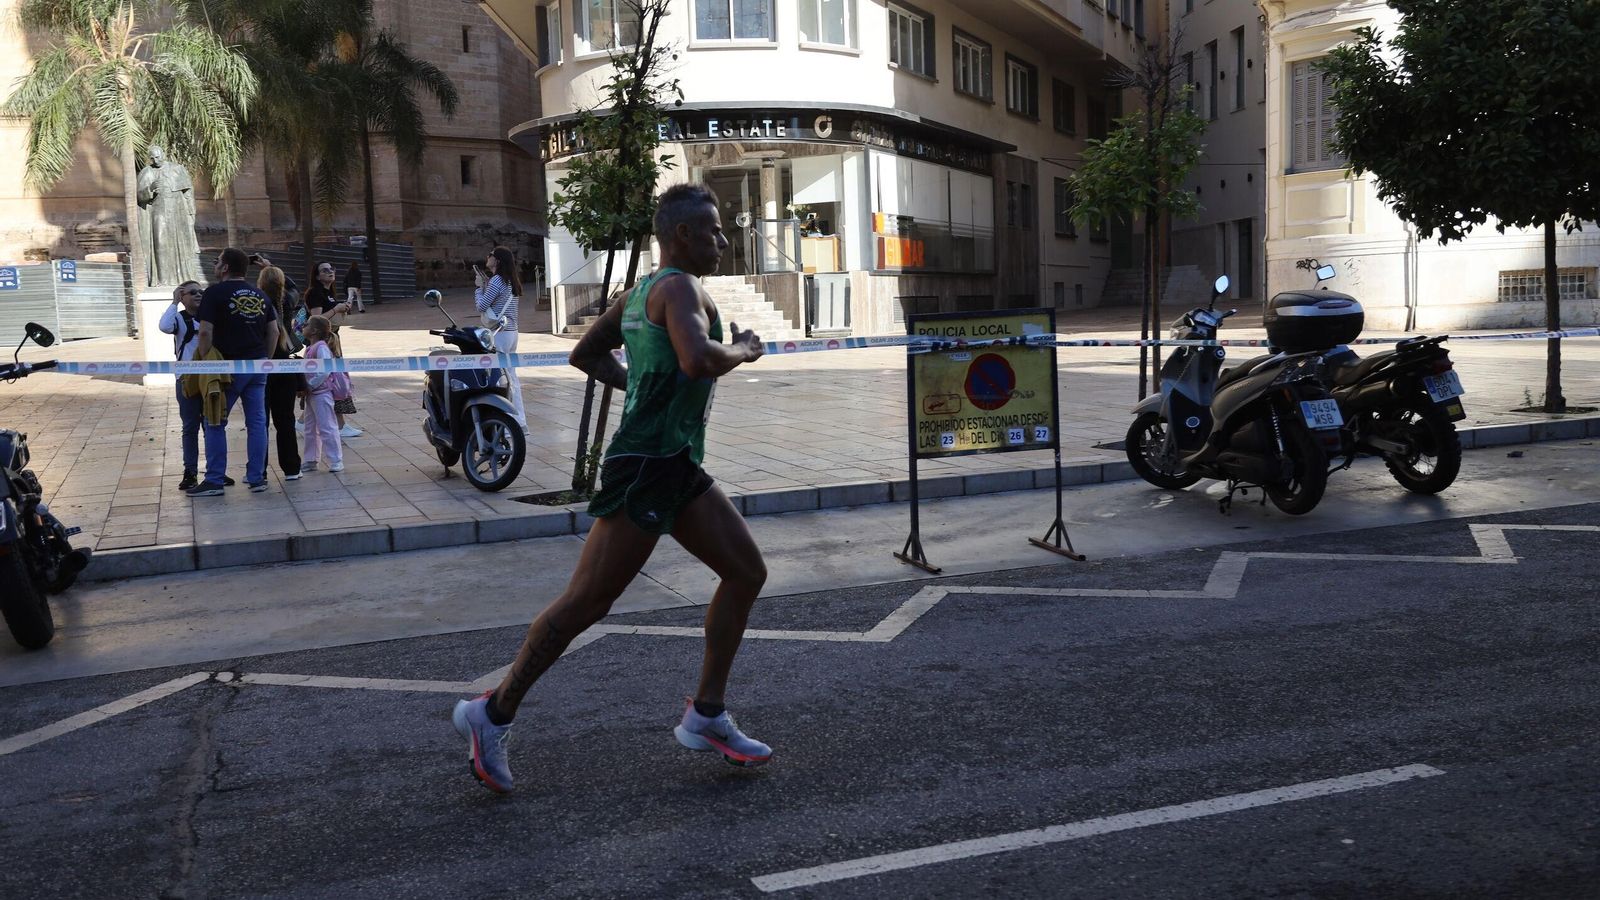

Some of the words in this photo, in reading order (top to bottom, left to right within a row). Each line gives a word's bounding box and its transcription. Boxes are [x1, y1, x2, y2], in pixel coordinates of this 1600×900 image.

[656, 120, 697, 141] EAL
[708, 118, 787, 138] ESTATE
[919, 326, 967, 337] POLICIA
[972, 324, 1011, 336] LOCAL
[1311, 402, 1336, 414] 9494
[919, 419, 965, 433] PROHIBIDO
[967, 414, 1018, 430] ESTACIONAR
[1314, 414, 1335, 425] MSB
[920, 435, 936, 448] LAS
[943, 435, 953, 445] 23
[971, 431, 988, 444] DEL
[1010, 431, 1021, 440] 26
[1036, 429, 1047, 438] 27
